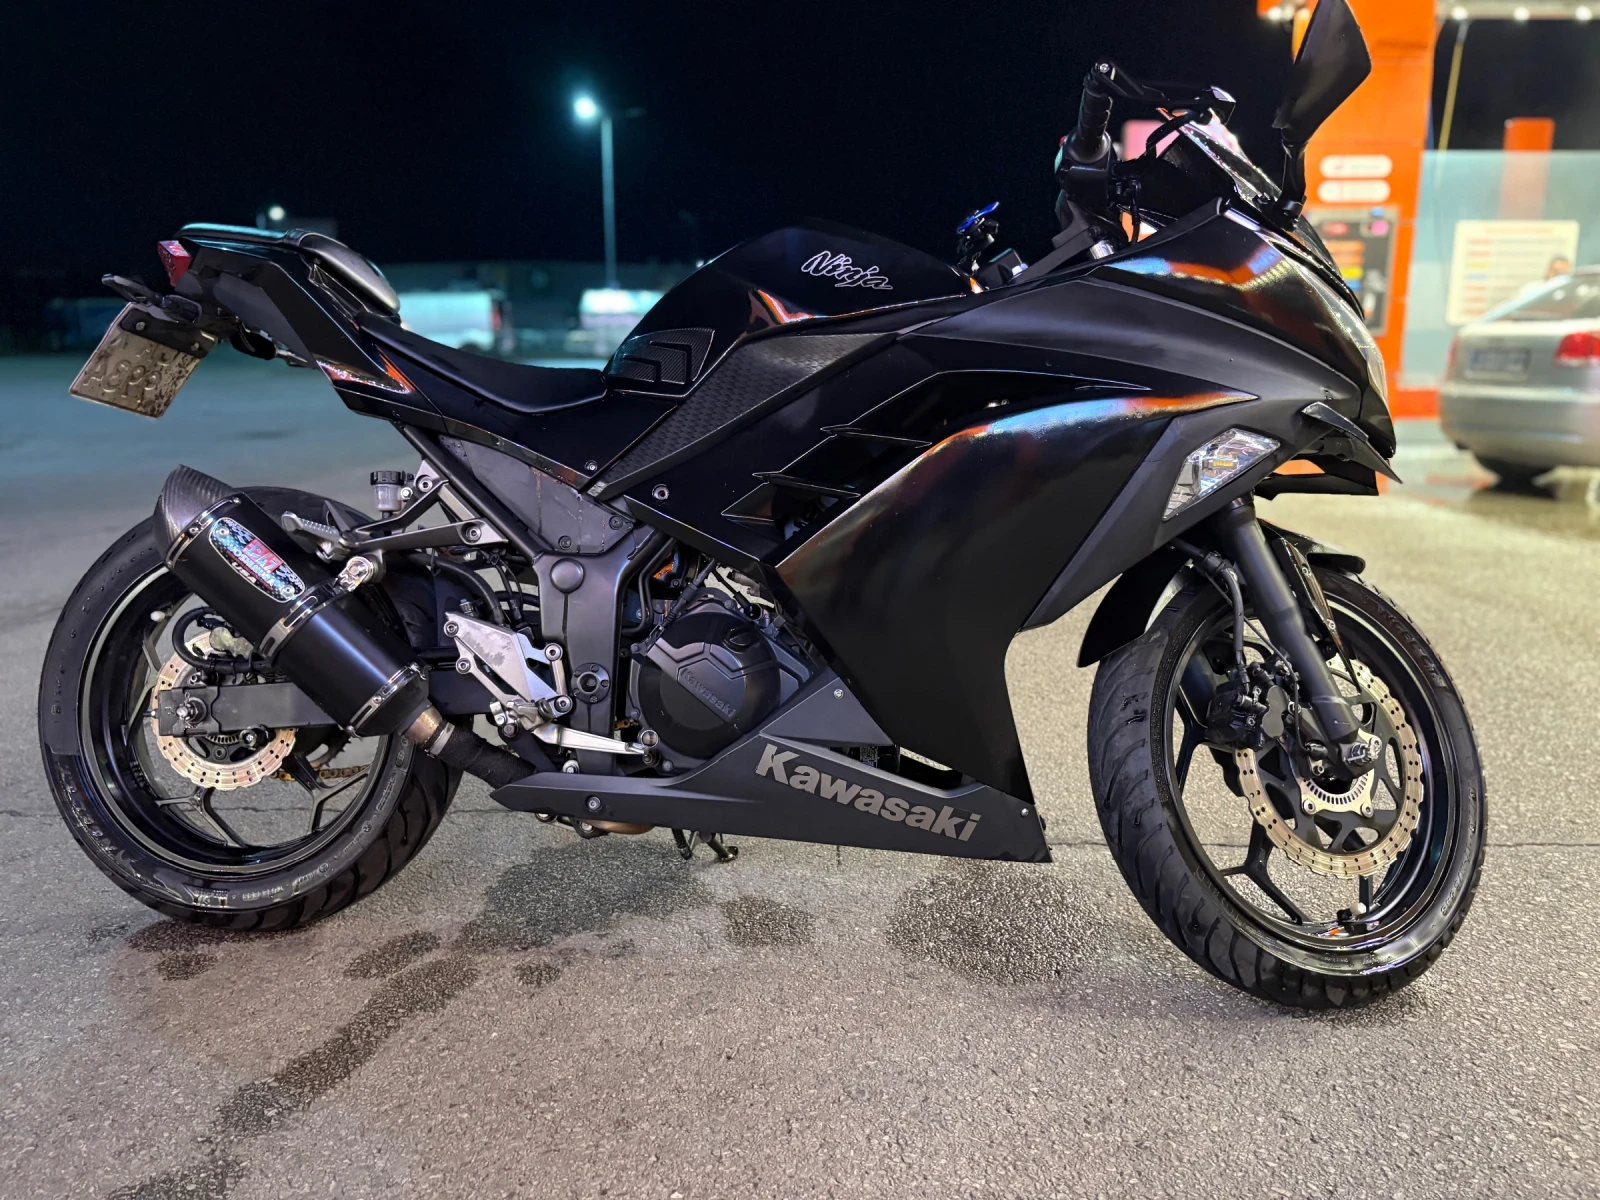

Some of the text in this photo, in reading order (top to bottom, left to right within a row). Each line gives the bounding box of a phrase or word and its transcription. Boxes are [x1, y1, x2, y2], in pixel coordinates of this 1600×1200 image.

[801, 250, 893, 290] Ninja
[231, 561, 257, 584] USA
[681, 668, 736, 718] Kawasaki
[755, 743, 982, 842] Kawasaki
